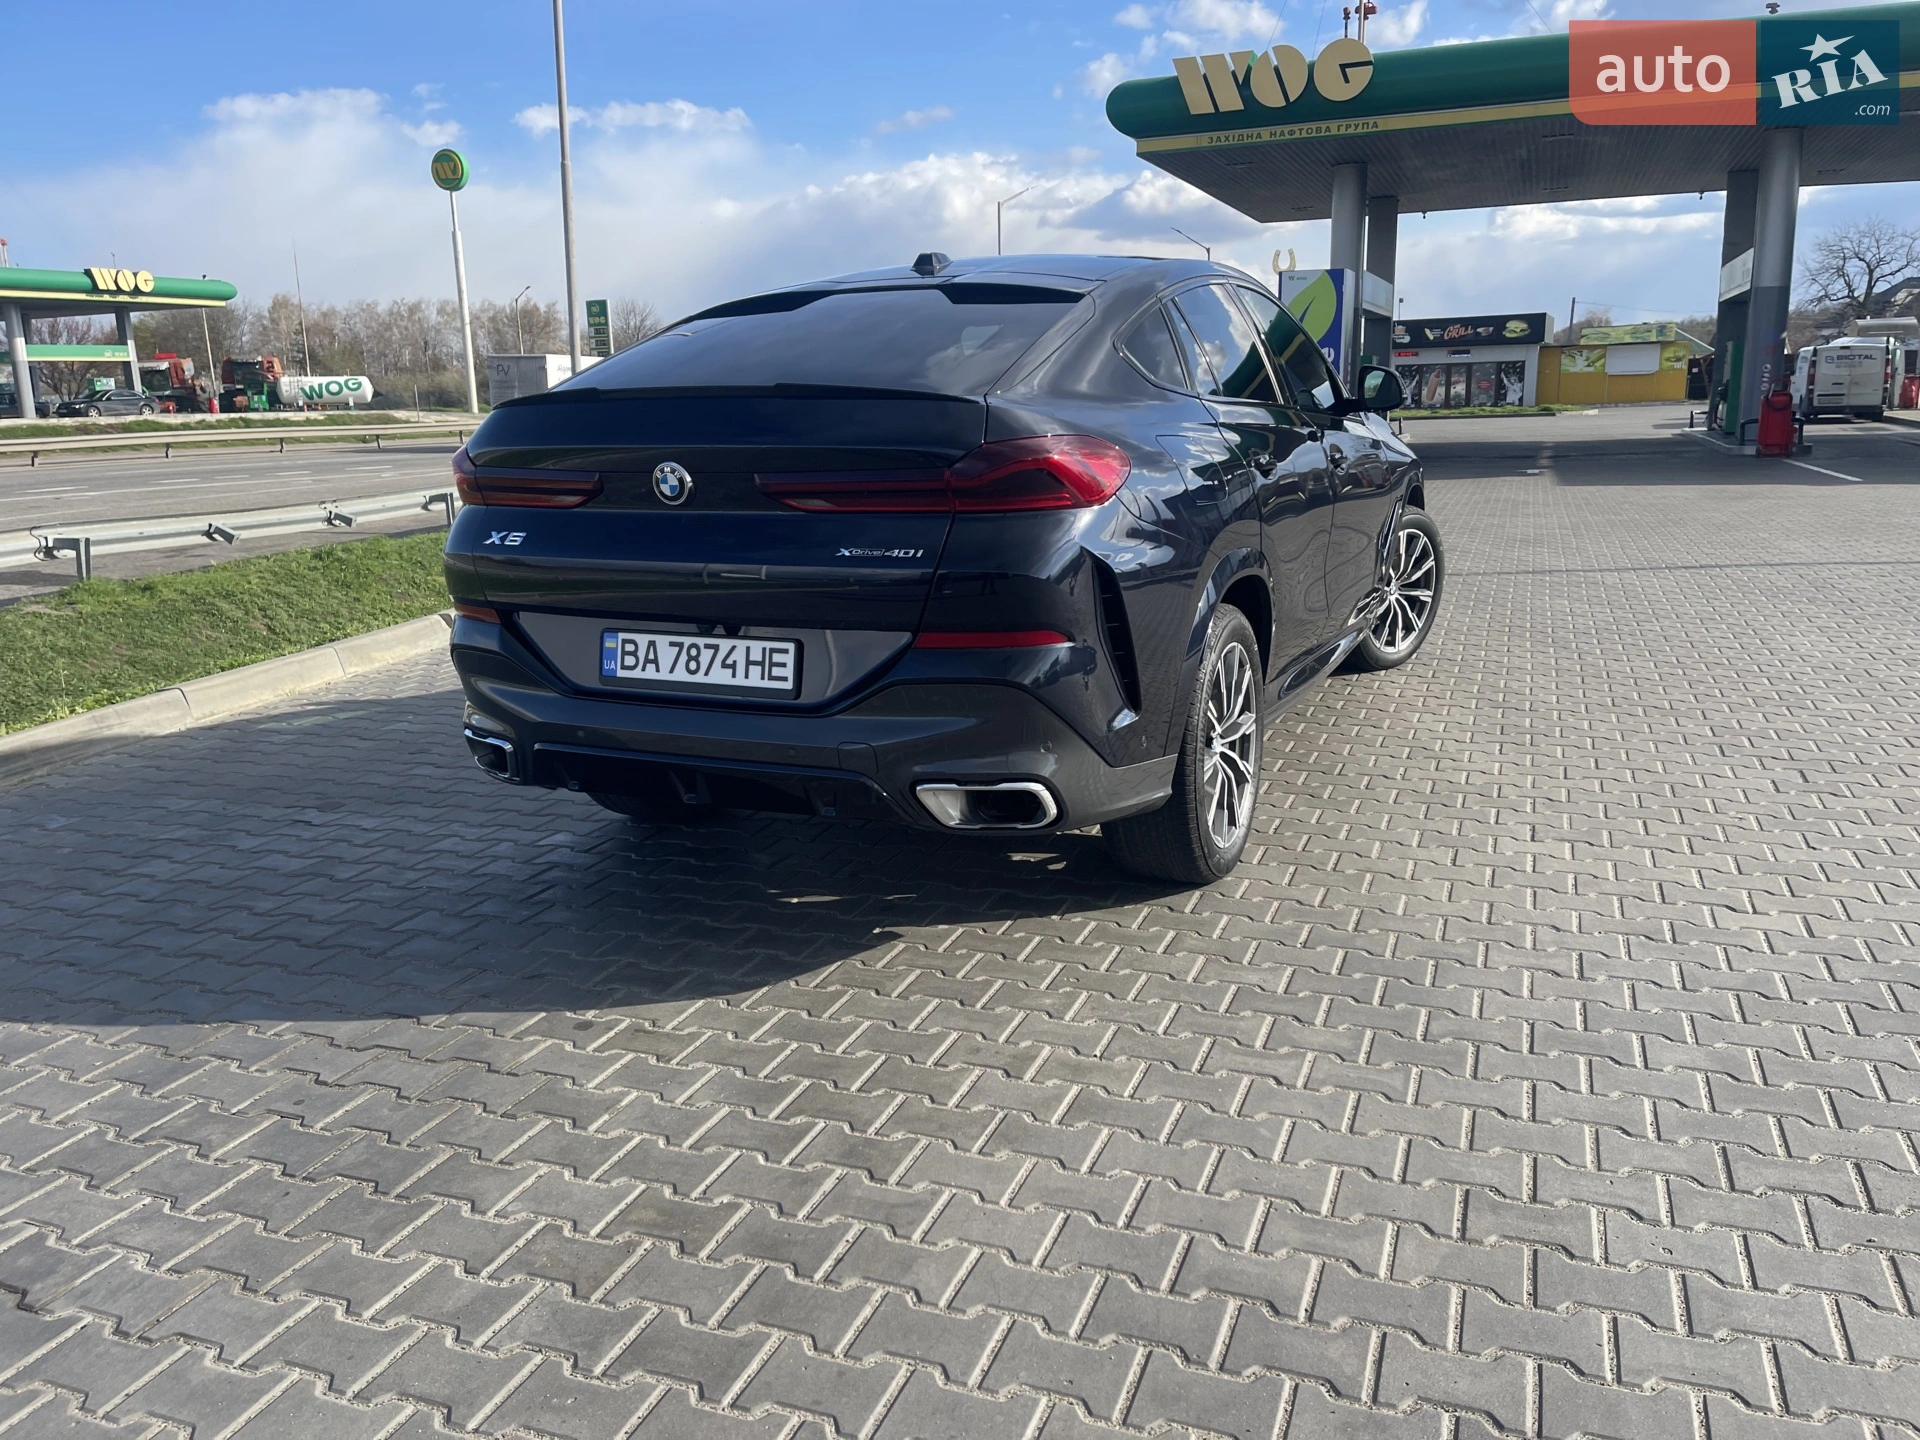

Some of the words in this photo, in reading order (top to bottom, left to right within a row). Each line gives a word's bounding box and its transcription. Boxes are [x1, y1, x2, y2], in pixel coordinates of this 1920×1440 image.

[1172, 37, 1374, 115] WOG
[1207, 132, 1263, 145] ЗАХІДНА
[1269, 126, 1332, 139] НАФТОВА
[1336, 120, 1380, 133] ГРУПА
[90, 267, 155, 293] WOG
[300, 377, 363, 401] WOG
[482, 531, 527, 546] X6
[604, 659, 616, 671] UA
